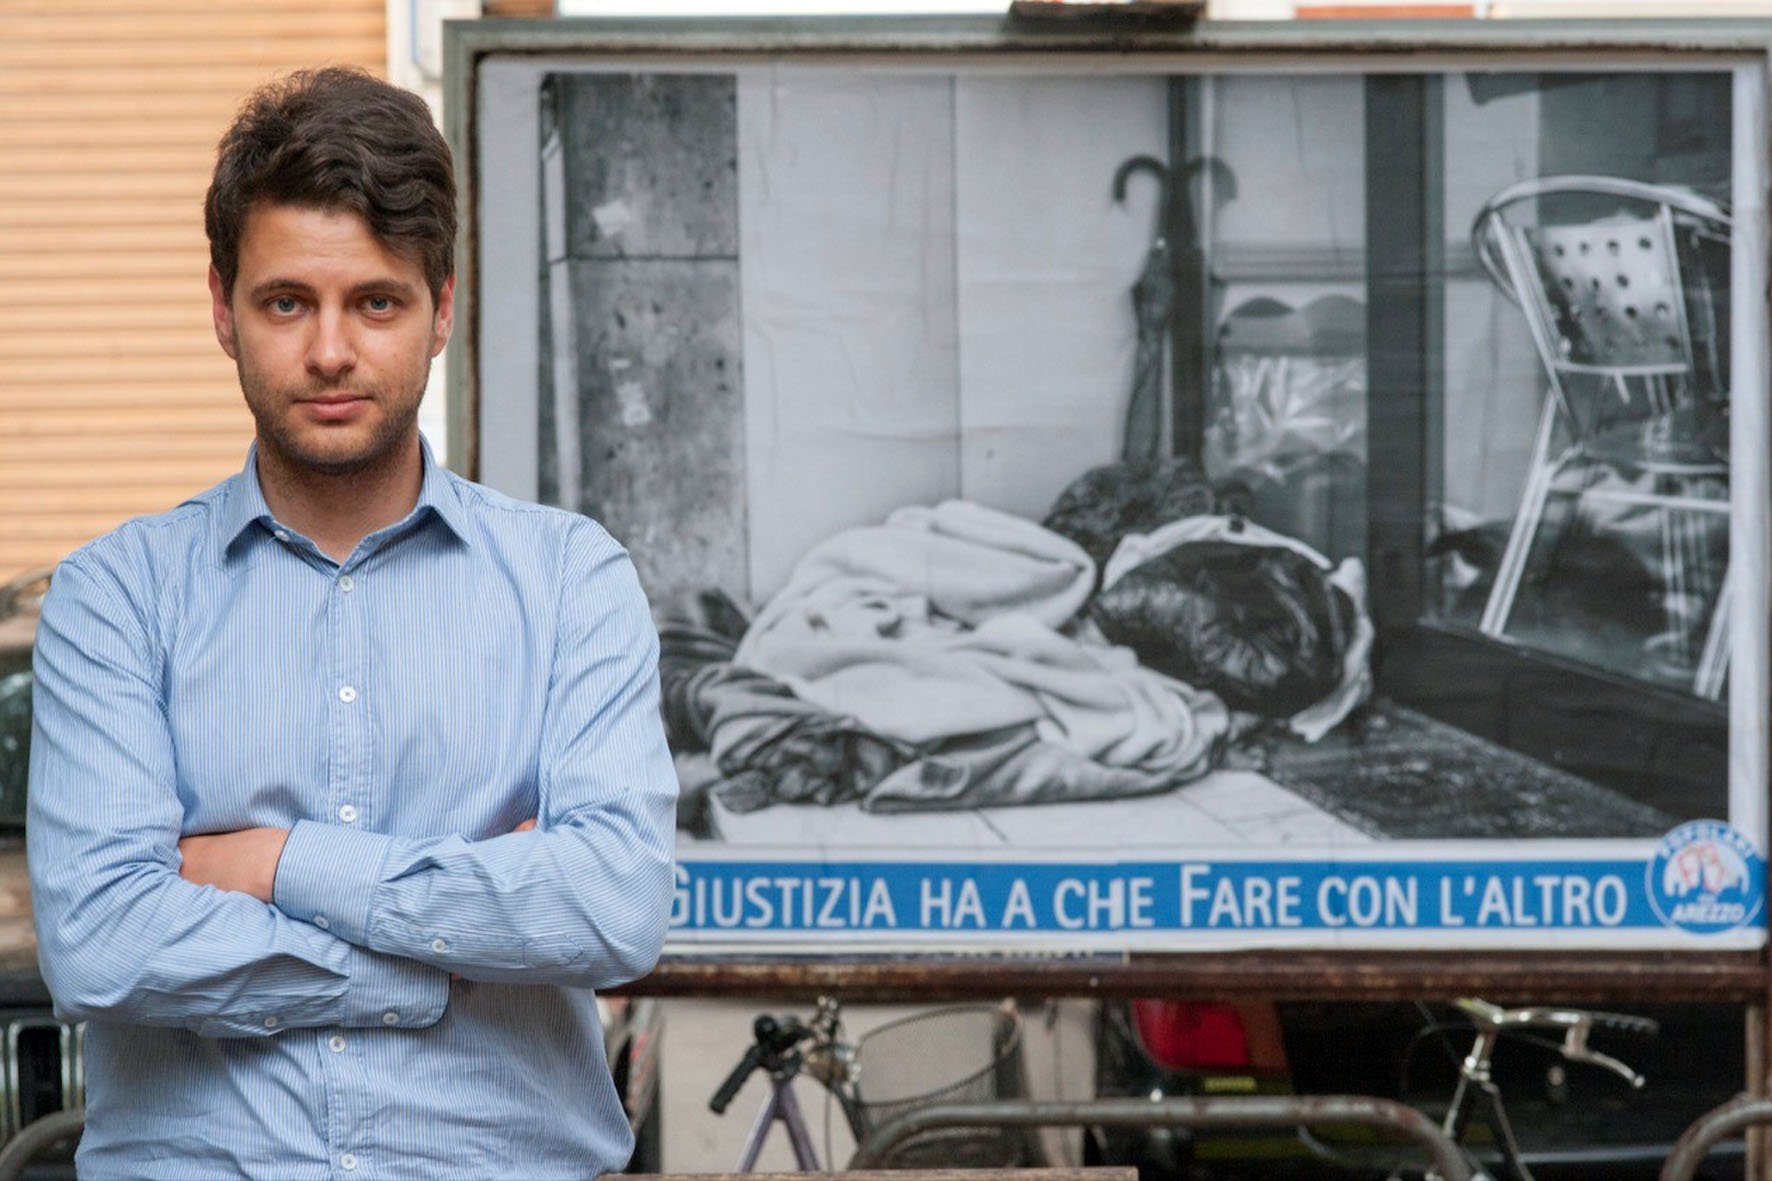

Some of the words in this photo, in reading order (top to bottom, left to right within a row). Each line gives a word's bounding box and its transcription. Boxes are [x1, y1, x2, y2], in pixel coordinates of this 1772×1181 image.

[921, 878, 986, 927] HA
[1003, 879, 1036, 927] A
[1053, 878, 1155, 929] CHE
[1180, 866, 1301, 926] FARE
[1317, 876, 1417, 926] CON
[1440, 875, 1627, 926] L'ALTRO
